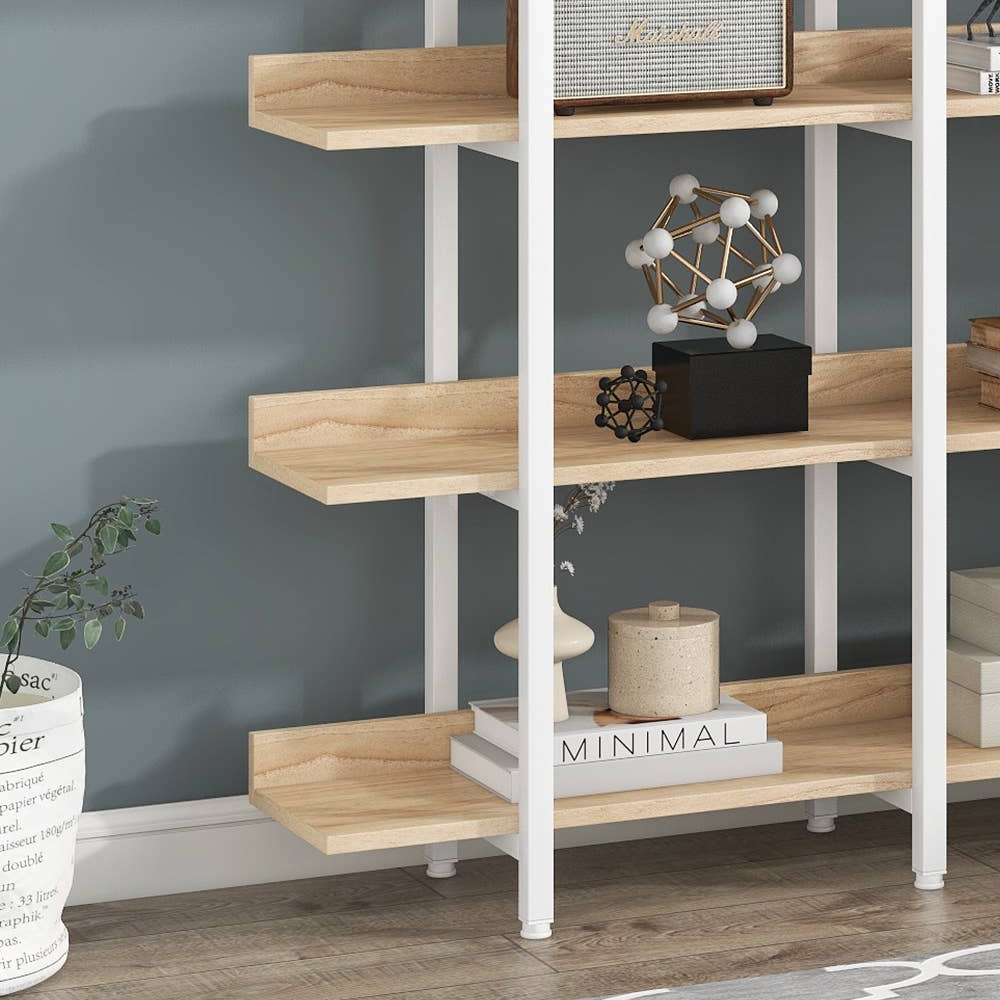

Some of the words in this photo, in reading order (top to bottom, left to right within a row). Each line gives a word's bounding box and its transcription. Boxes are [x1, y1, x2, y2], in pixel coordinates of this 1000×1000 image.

[615, 18, 723, 44] Marshall
[20, 672, 51, 691] sac
[562, 722, 741, 763] MINIMAL
[0, 796, 37, 817] papier
[2, 851, 44, 873] doublé
[17, 894, 33, 908] 33
